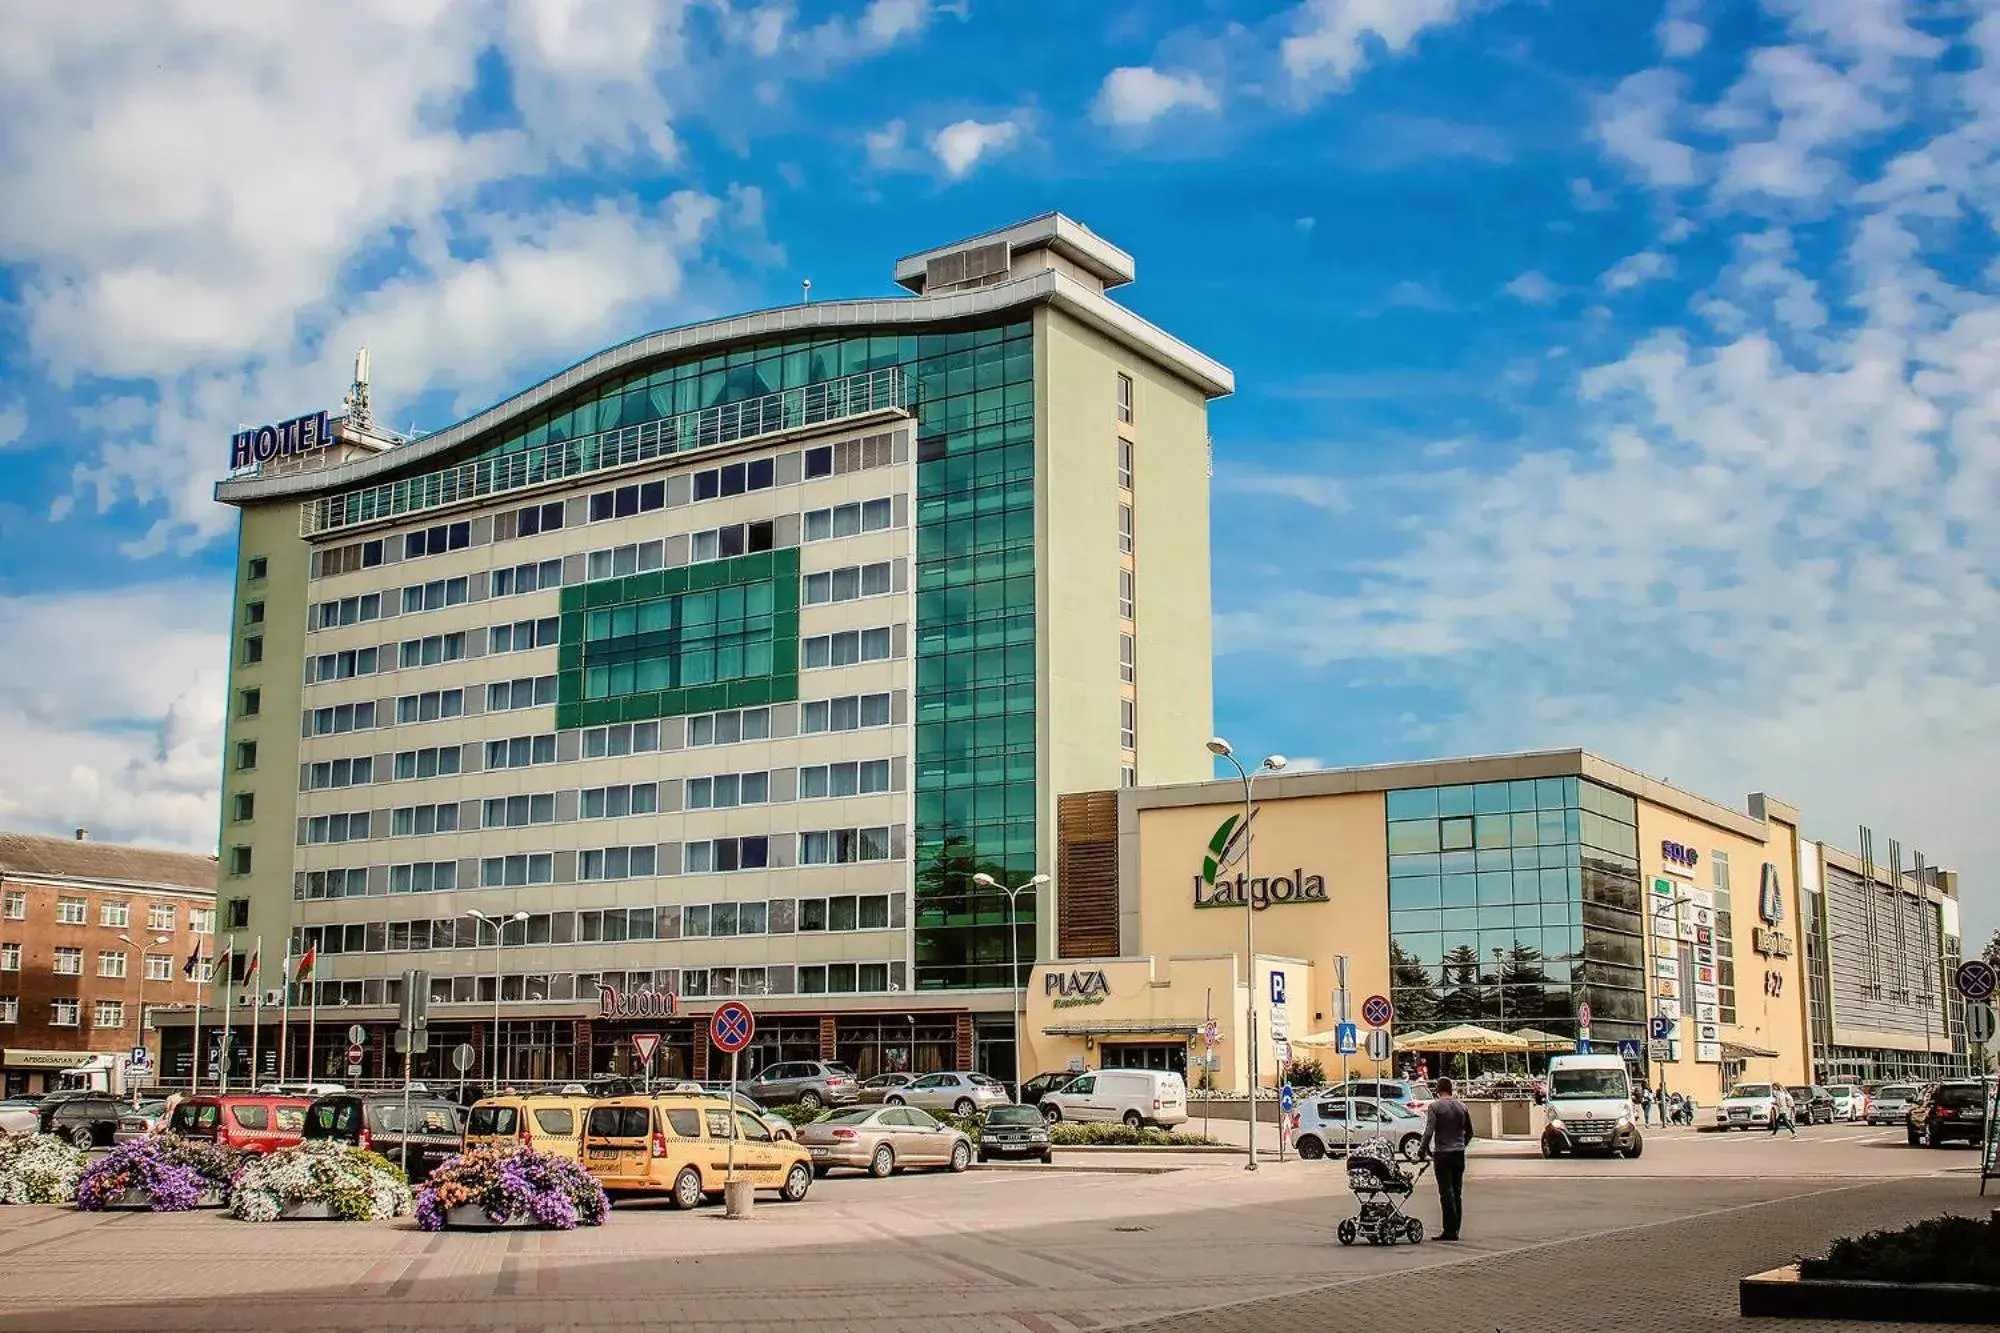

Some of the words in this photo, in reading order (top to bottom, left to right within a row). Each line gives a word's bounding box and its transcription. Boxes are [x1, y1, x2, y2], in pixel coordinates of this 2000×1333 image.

[230, 410, 335, 470] HOTEL
[1193, 867, 1327, 912] Latgola
[1045, 968, 1111, 997] PLAZA
[1272, 975, 1283, 1001] P
[1653, 1022, 1663, 1037] P
[133, 1050, 145, 1064] P
[210, 1049, 218, 1062] P
